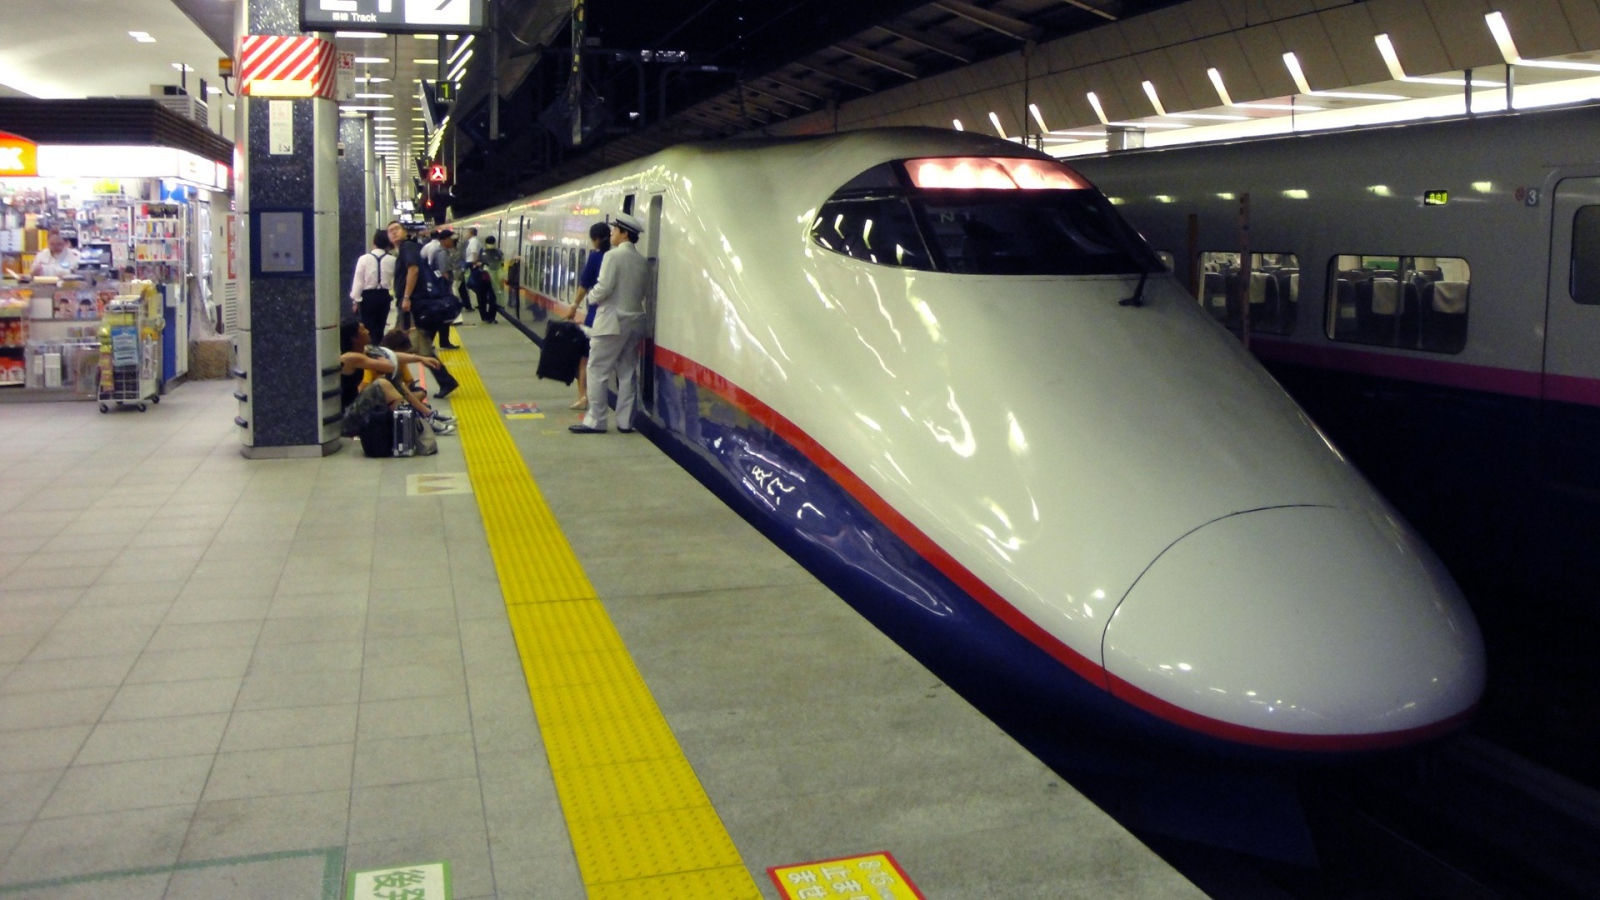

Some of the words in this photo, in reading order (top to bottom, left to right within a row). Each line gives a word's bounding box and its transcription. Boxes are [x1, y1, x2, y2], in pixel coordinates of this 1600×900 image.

[351, 12, 377, 22] Track
[1528, 189, 1537, 205] 3
[820, 866, 870, 900] 止ま
